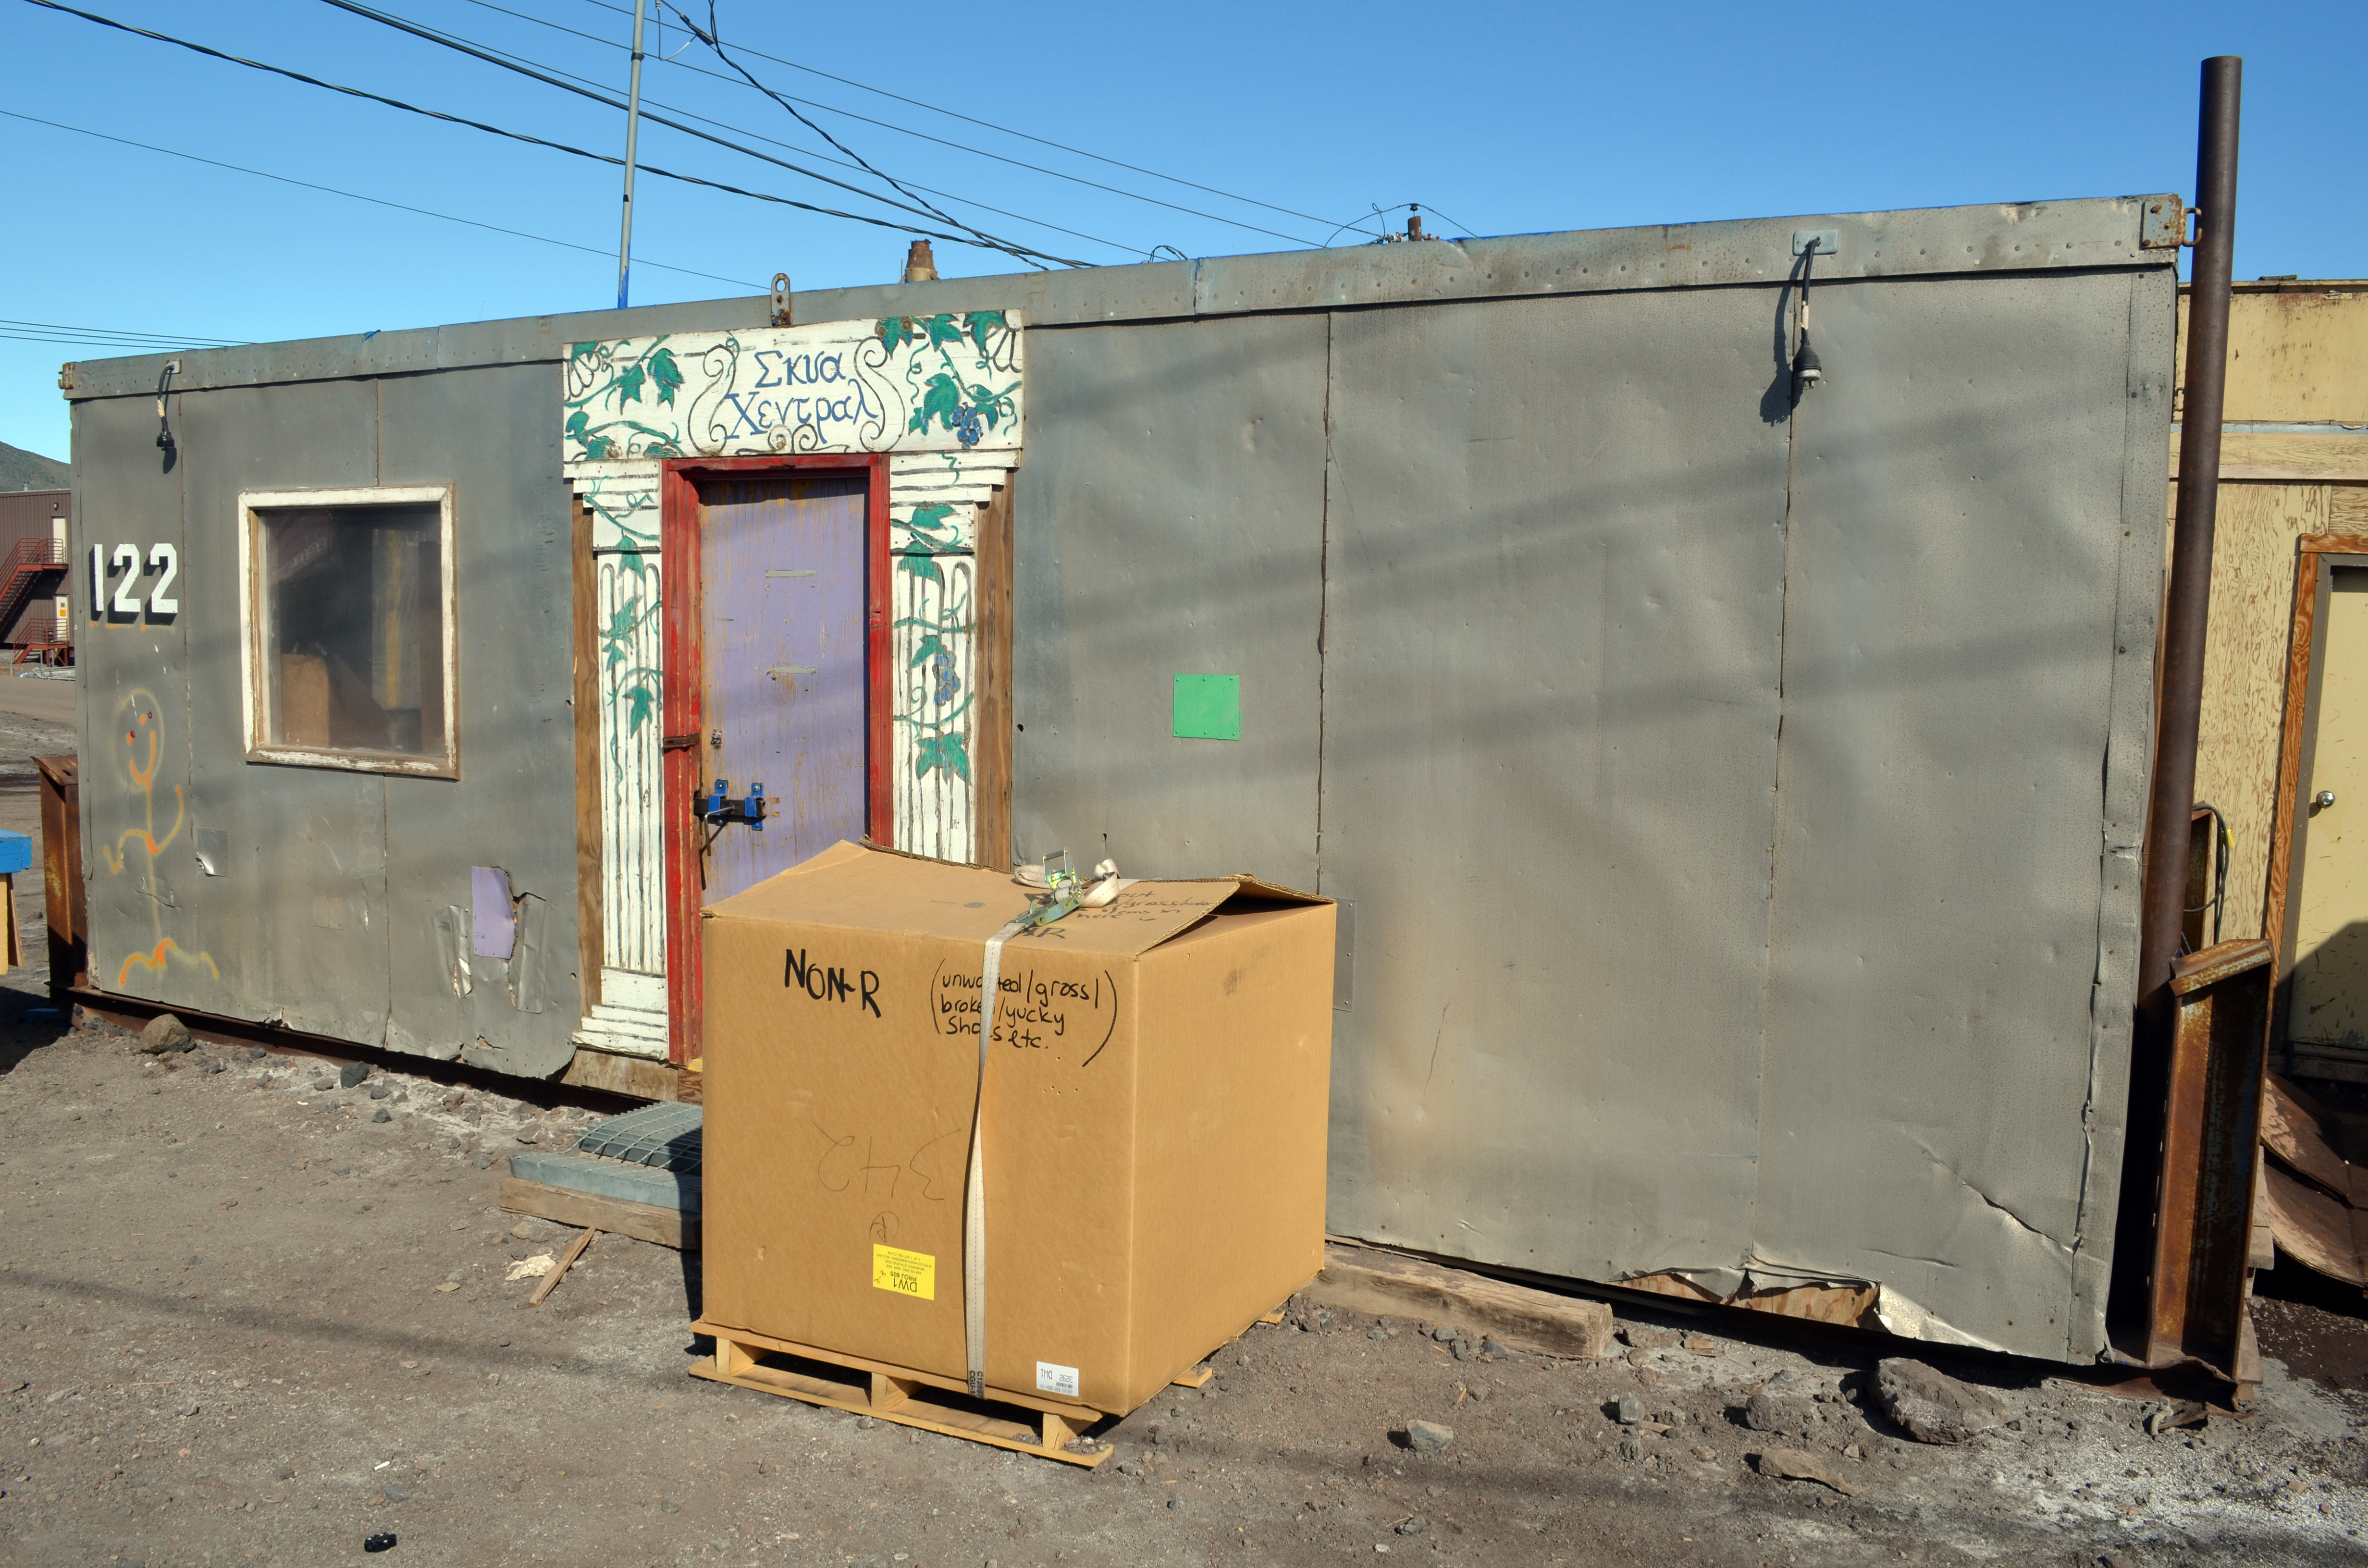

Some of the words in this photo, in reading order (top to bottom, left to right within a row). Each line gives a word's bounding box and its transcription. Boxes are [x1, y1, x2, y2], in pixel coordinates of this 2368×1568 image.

[754, 350, 846, 388] Σκυα
[89, 543, 178, 625] 122
[946, 1015, 1002, 1041] Shos
[893, 1278, 917, 1293] DW1
[901, 1274, 917, 1282] PROJ
[1040, 1369, 1053, 1379] DW1
